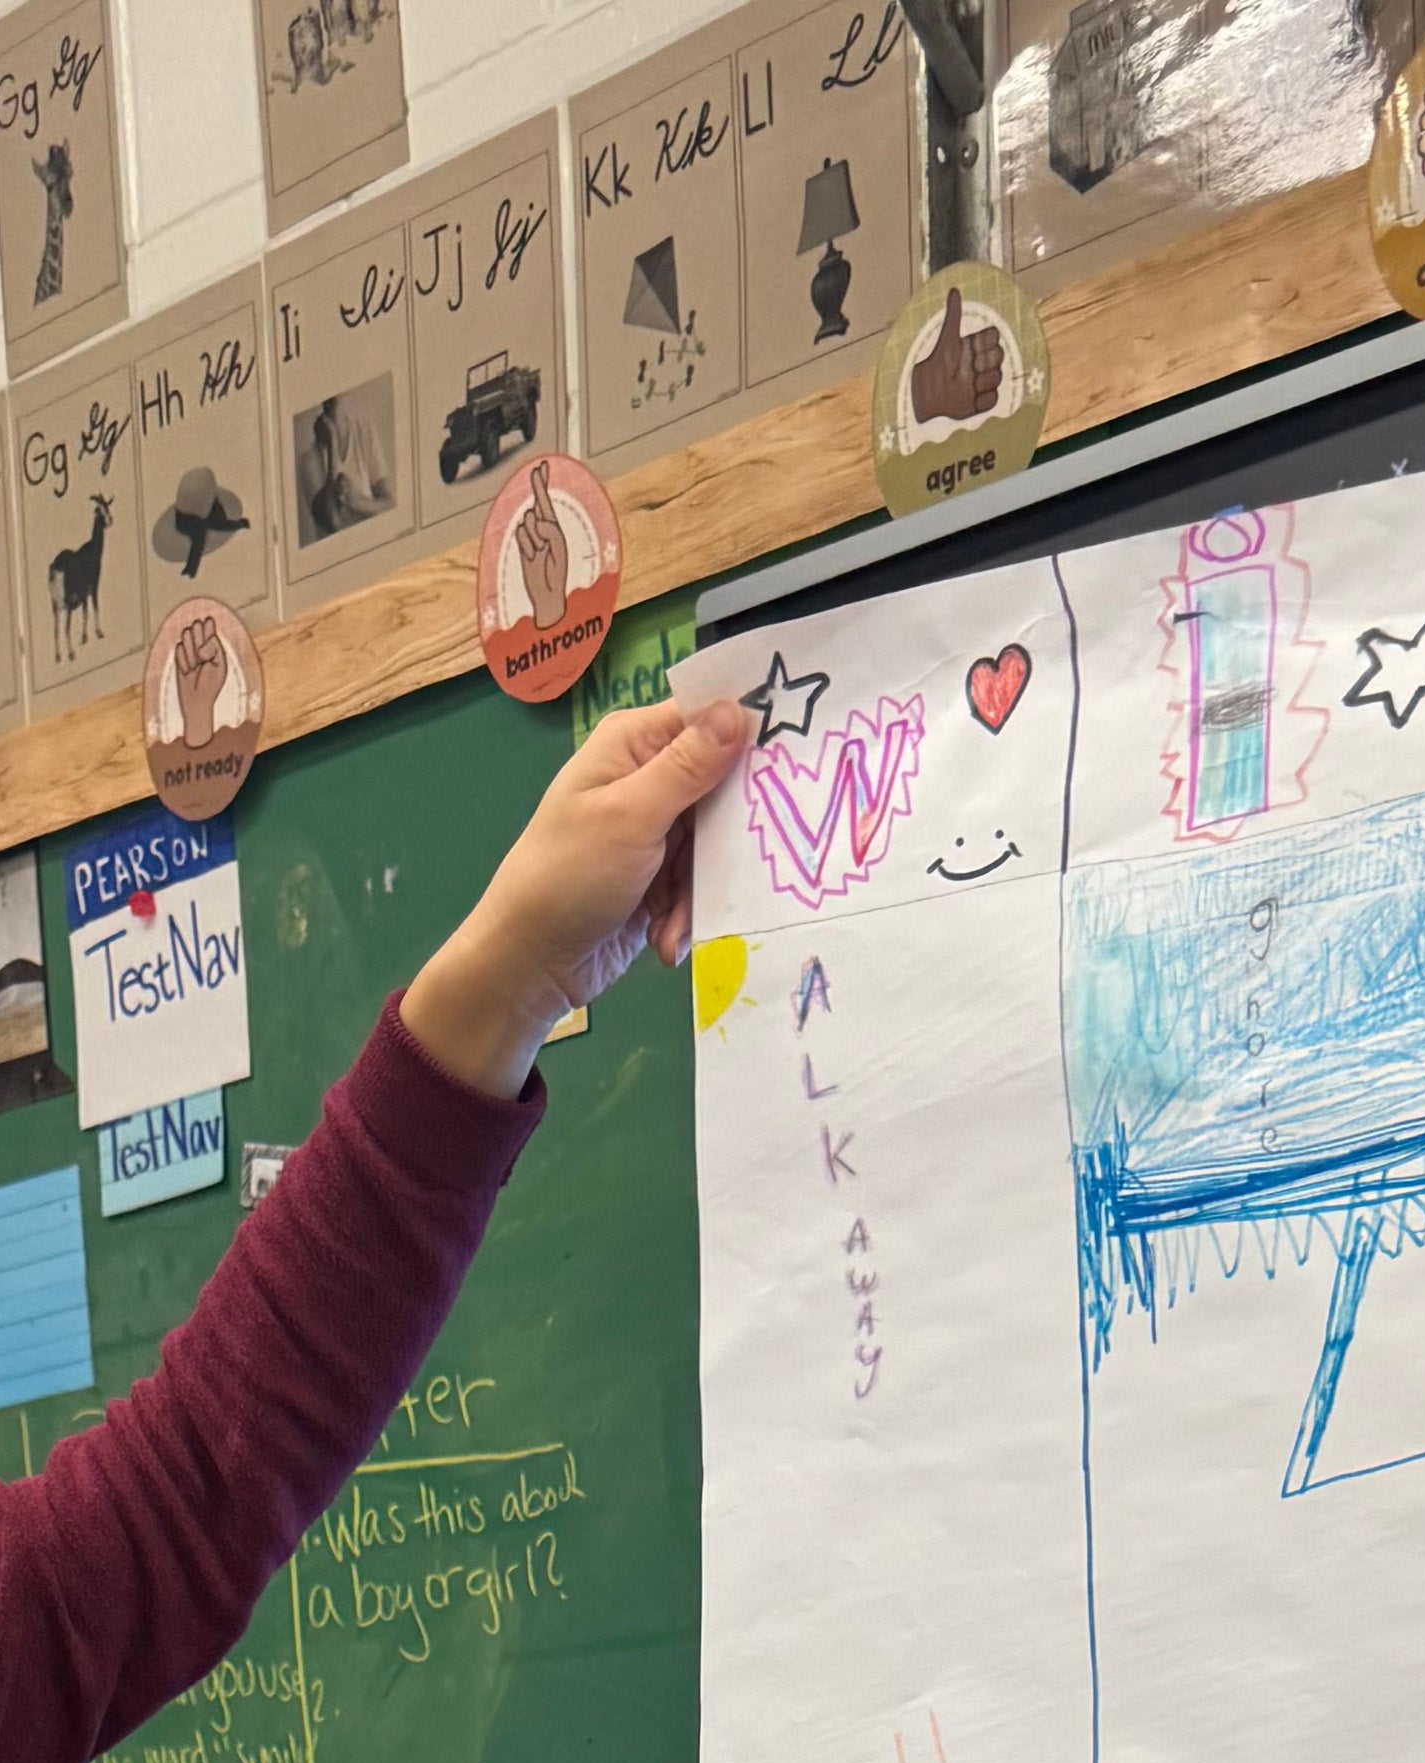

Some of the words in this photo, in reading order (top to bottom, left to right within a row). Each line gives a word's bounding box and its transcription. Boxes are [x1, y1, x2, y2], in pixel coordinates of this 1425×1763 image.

[584, 144, 632, 218] Kk
[415, 224, 463, 311] Jj
[280, 302, 300, 364] Ii
[141, 373, 183, 437] Hh
[24, 430, 67, 497] Gg
[925, 445, 997, 494] agree
[506, 615, 603, 679] bathroom
[164, 767, 191, 787] not
[196, 753, 243, 779] ready
[75, 825, 208, 915] PEARSON
[84, 900, 239, 1022] TestNav
[380, 1373, 496, 1451] ter
[325, 1485, 406, 1562] Was
[413, 1482, 485, 1537] this
[309, 1585, 343, 1627] a
[353, 1563, 430, 1662] boy
[425, 1566, 463, 1609] or
